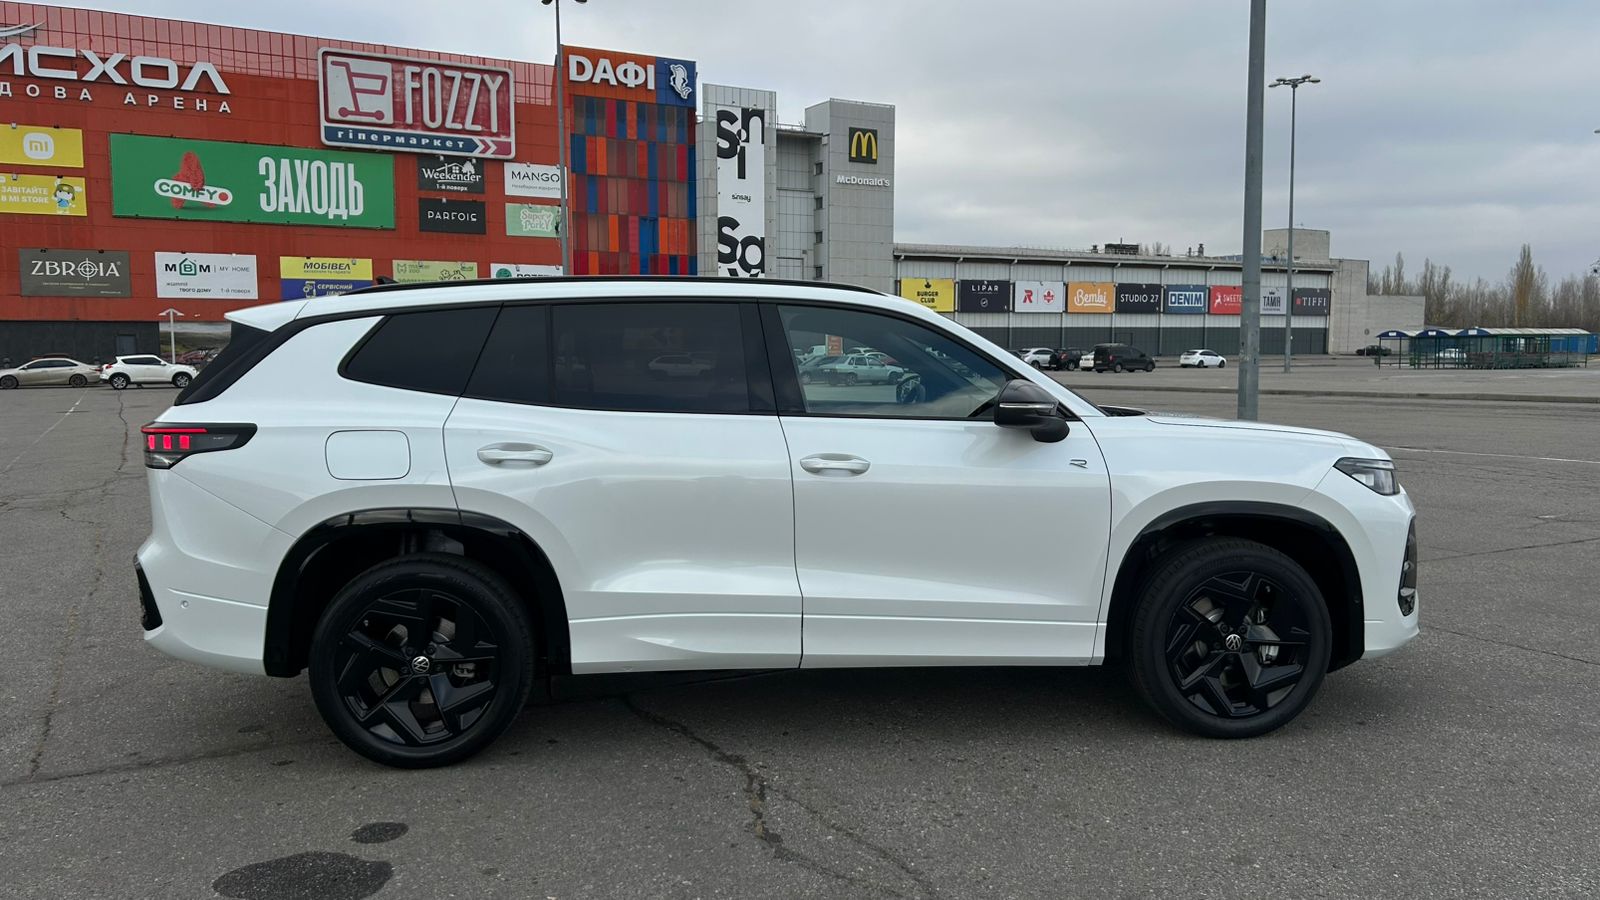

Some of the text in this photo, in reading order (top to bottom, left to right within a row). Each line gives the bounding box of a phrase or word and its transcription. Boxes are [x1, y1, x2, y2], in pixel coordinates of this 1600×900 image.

[124, 92, 231, 114] АРЕНА
[405, 66, 503, 134] FOZZY
[337, 129, 465, 148] гіпермаркет
[422, 163, 482, 182] Weekender
[511, 170, 560, 183] MANGO
[836, 174, 890, 187] McDonald's
[1, 186, 49, 195] ЗАВІТАЙТЕ
[158, 180, 218, 201] COMFY
[258, 156, 364, 220] ЗАХОДЬ
[9, 195, 20, 203] MI
[21, 196, 49, 204] STORE
[731, 193, 751, 203] sinsay
[427, 210, 478, 222] PARFOIS
[303, 262, 351, 271] МОБІВЕЛ
[971, 284, 999, 292] LIPAR
[1074, 289, 1108, 306] Bembi
[1120, 294, 1159, 303] STUDIO 27
[1169, 293, 1203, 306] DENIM
[1302, 297, 1327, 306] TIFFI
